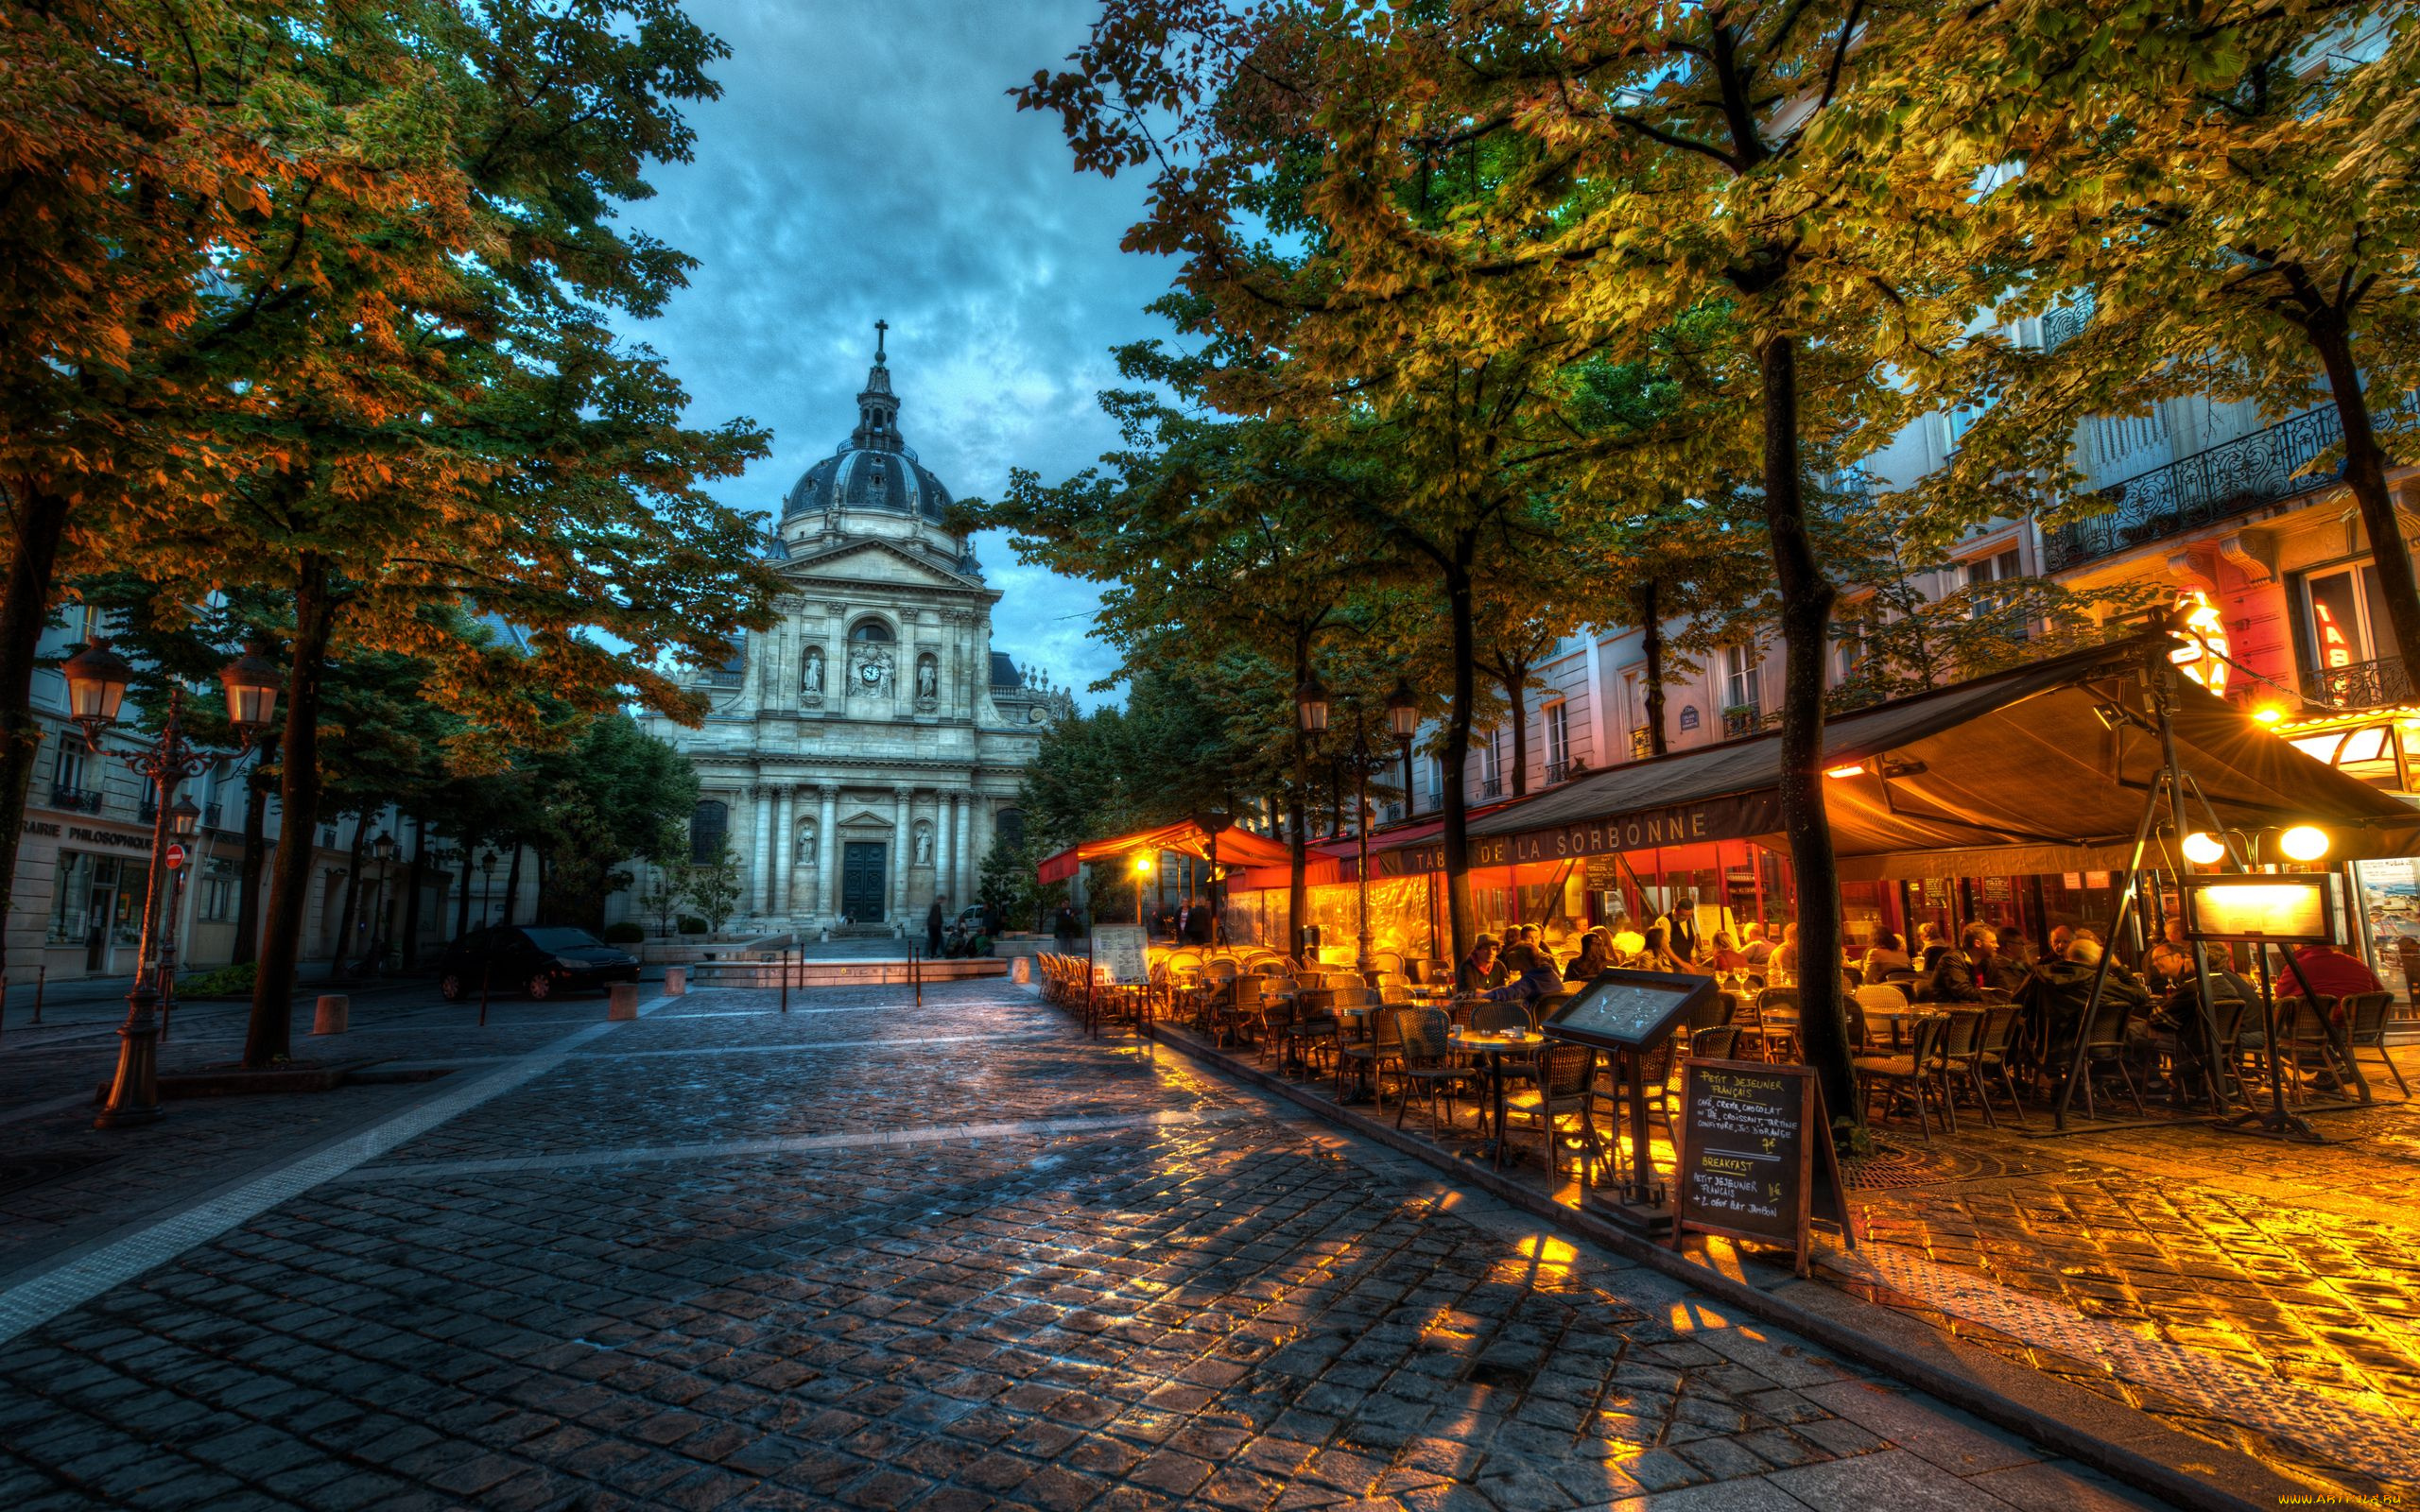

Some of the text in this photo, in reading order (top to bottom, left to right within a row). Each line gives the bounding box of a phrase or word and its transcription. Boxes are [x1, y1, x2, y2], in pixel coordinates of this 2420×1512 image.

[1416, 813, 1707, 870] TAB DE LA SORBONNE
[1703, 1157, 1754, 1172] BREAKFAST
